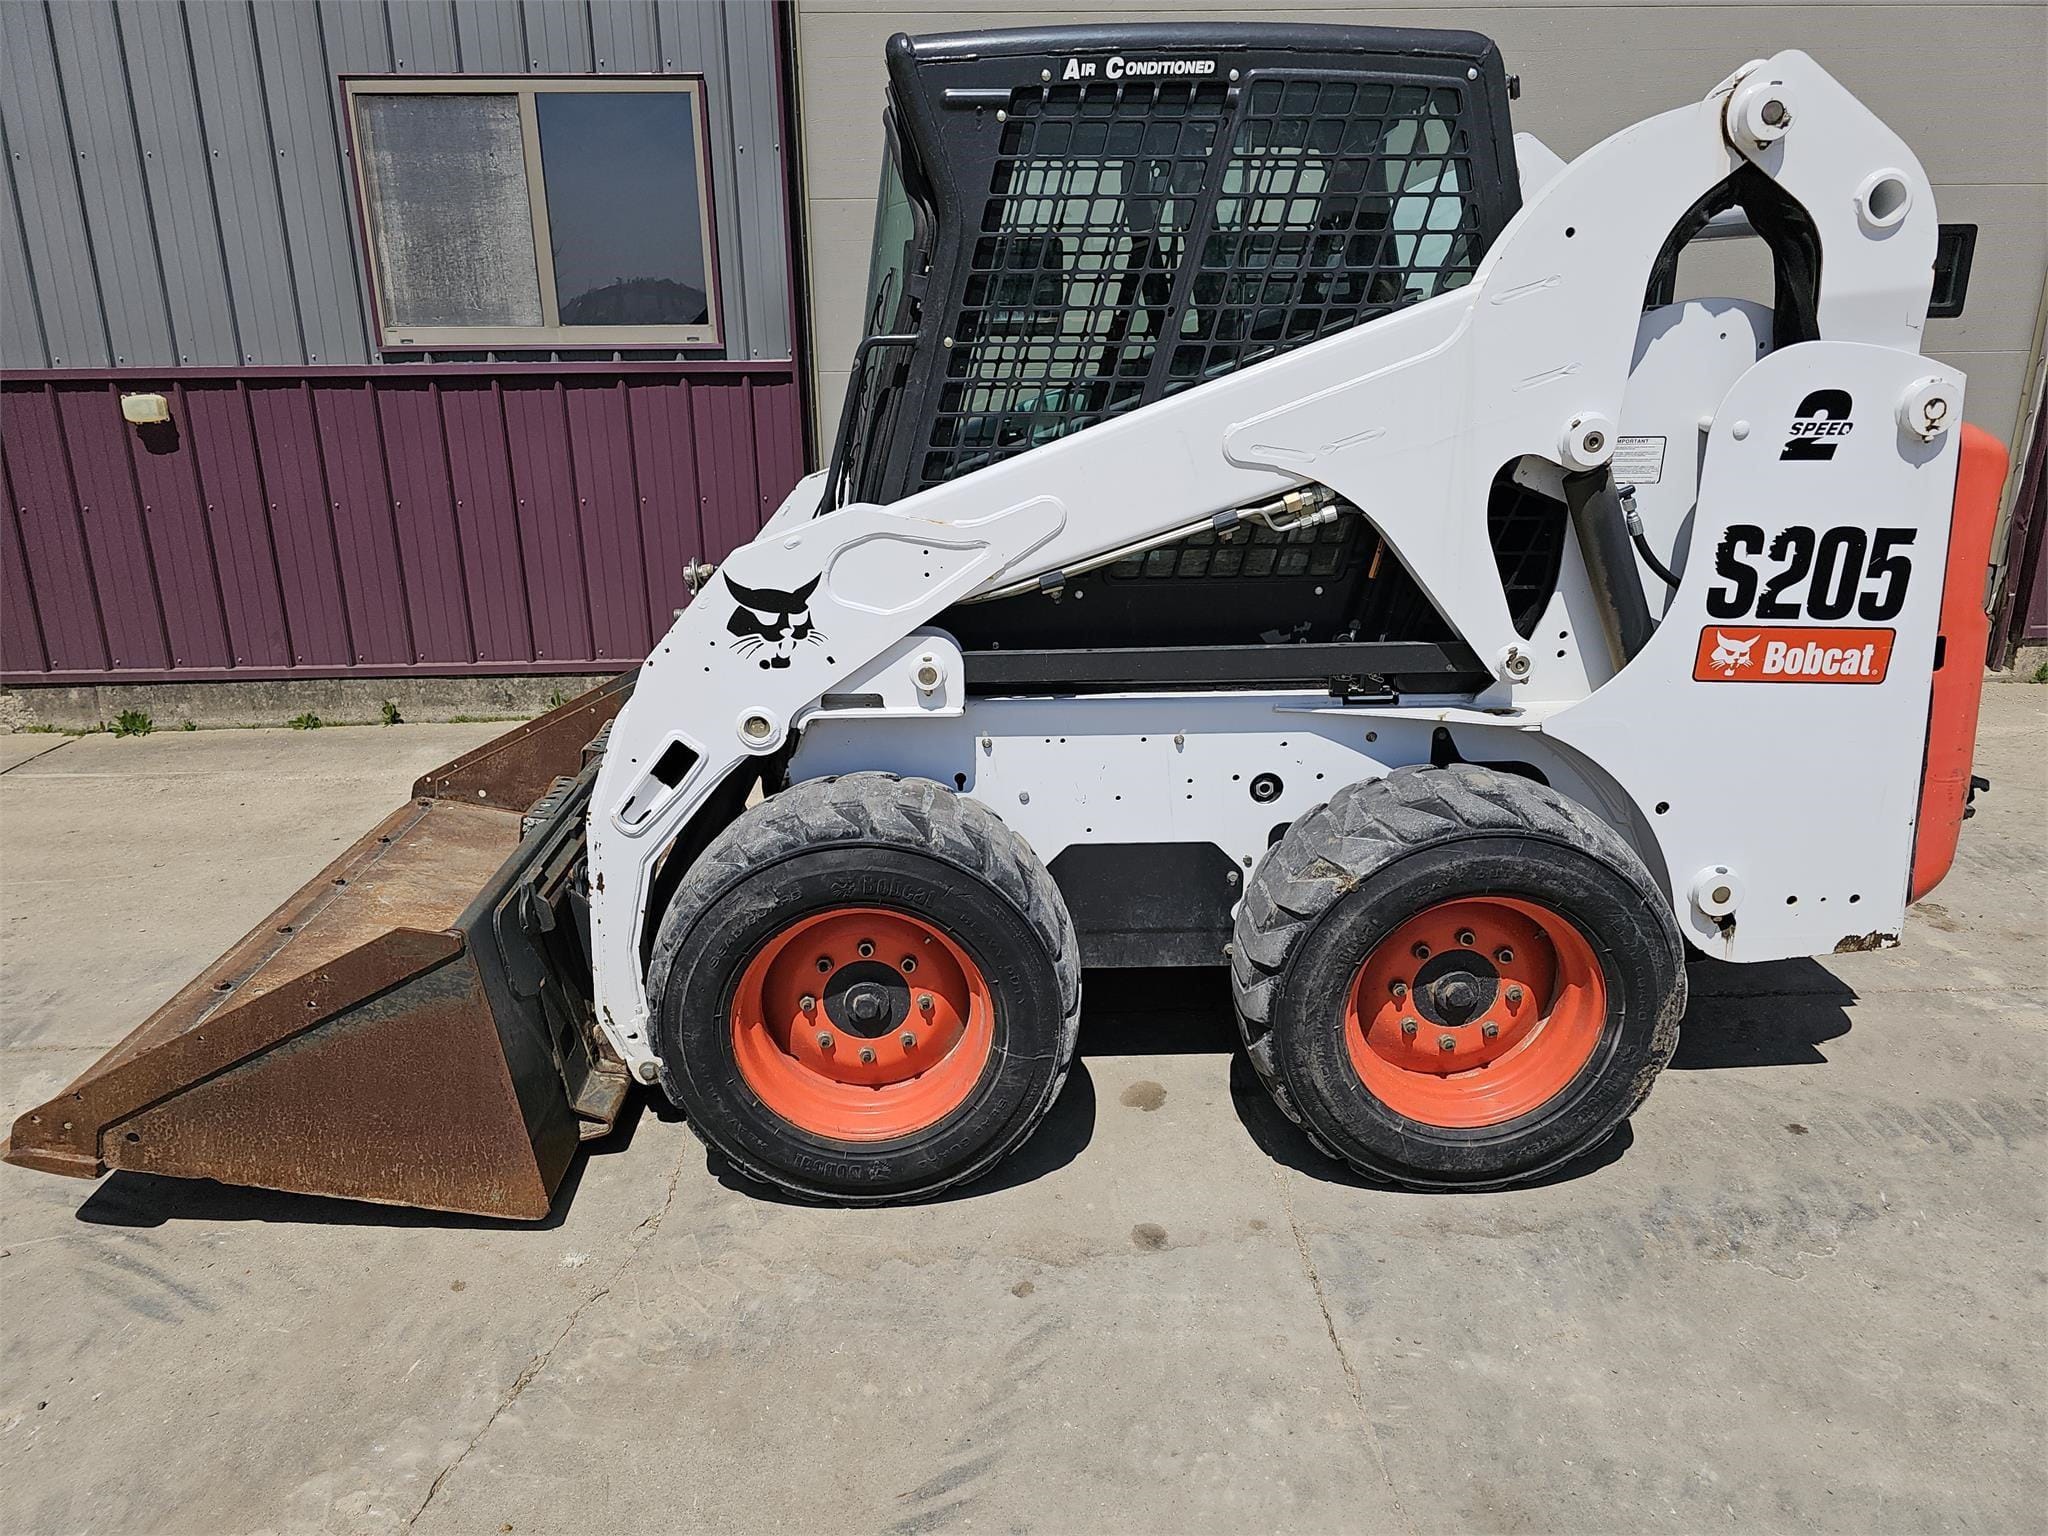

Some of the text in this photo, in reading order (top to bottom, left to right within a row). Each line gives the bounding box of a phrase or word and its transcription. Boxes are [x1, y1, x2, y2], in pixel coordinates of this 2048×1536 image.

[1062, 56, 1216, 80] AIR CONDITIONED
[1779, 388, 1854, 461] 2 SPEED
[1706, 524, 1918, 621] S205
[1761, 640, 1875, 676] Bobcat
